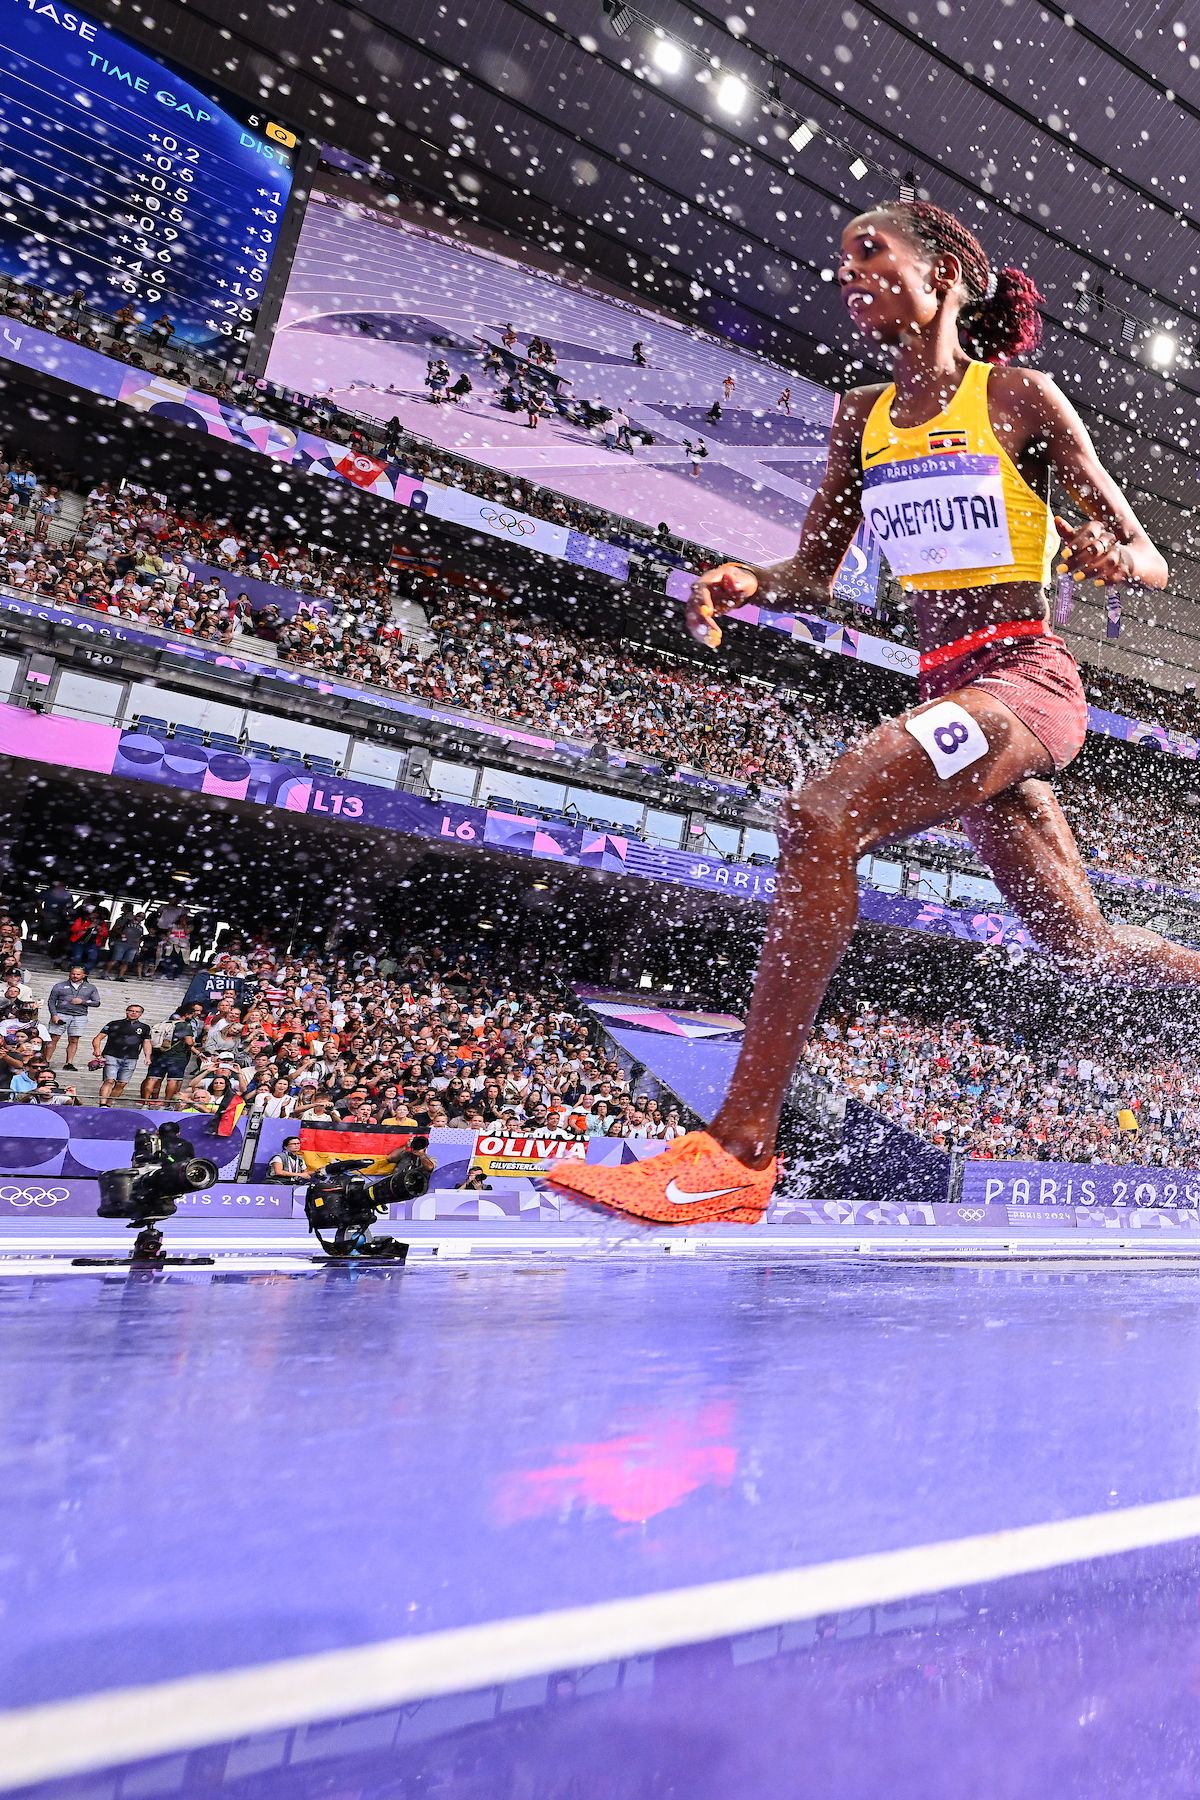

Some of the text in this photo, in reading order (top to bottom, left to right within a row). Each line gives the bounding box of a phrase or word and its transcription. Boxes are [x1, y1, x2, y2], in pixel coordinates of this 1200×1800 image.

[88, 51, 211, 122] TIME GAP
[247, 114, 259, 127] 5
[148, 132, 282, 206] +0.2 +1
[239, 132, 292, 169] DIST.
[142, 152, 278, 224] +0.5 +3
[136, 171, 273, 244] +0.5 +3
[130, 192, 268, 263] +0.5 +3
[124, 213, 263, 283] +0.9 +5
[118, 233, 259, 301] +3.6 +19
[112, 254, 252, 322] +4.6 +25
[106, 275, 248, 343] +5.9 +31
[870, 496, 999, 542] CHEMUTAI
[85, 650, 114, 665] 120
[376, 723, 397, 735] 119
[933, 721, 969, 755] 8
[313, 789, 364, 818] L13
[440, 816, 476, 840] L6
[478, 1136, 587, 1160] OLIVIA
[221, 1195, 280, 1206] 2024
[1111, 1180, 1200, 1209] 2024
[1043, 1212, 1070, 1220] 2024
